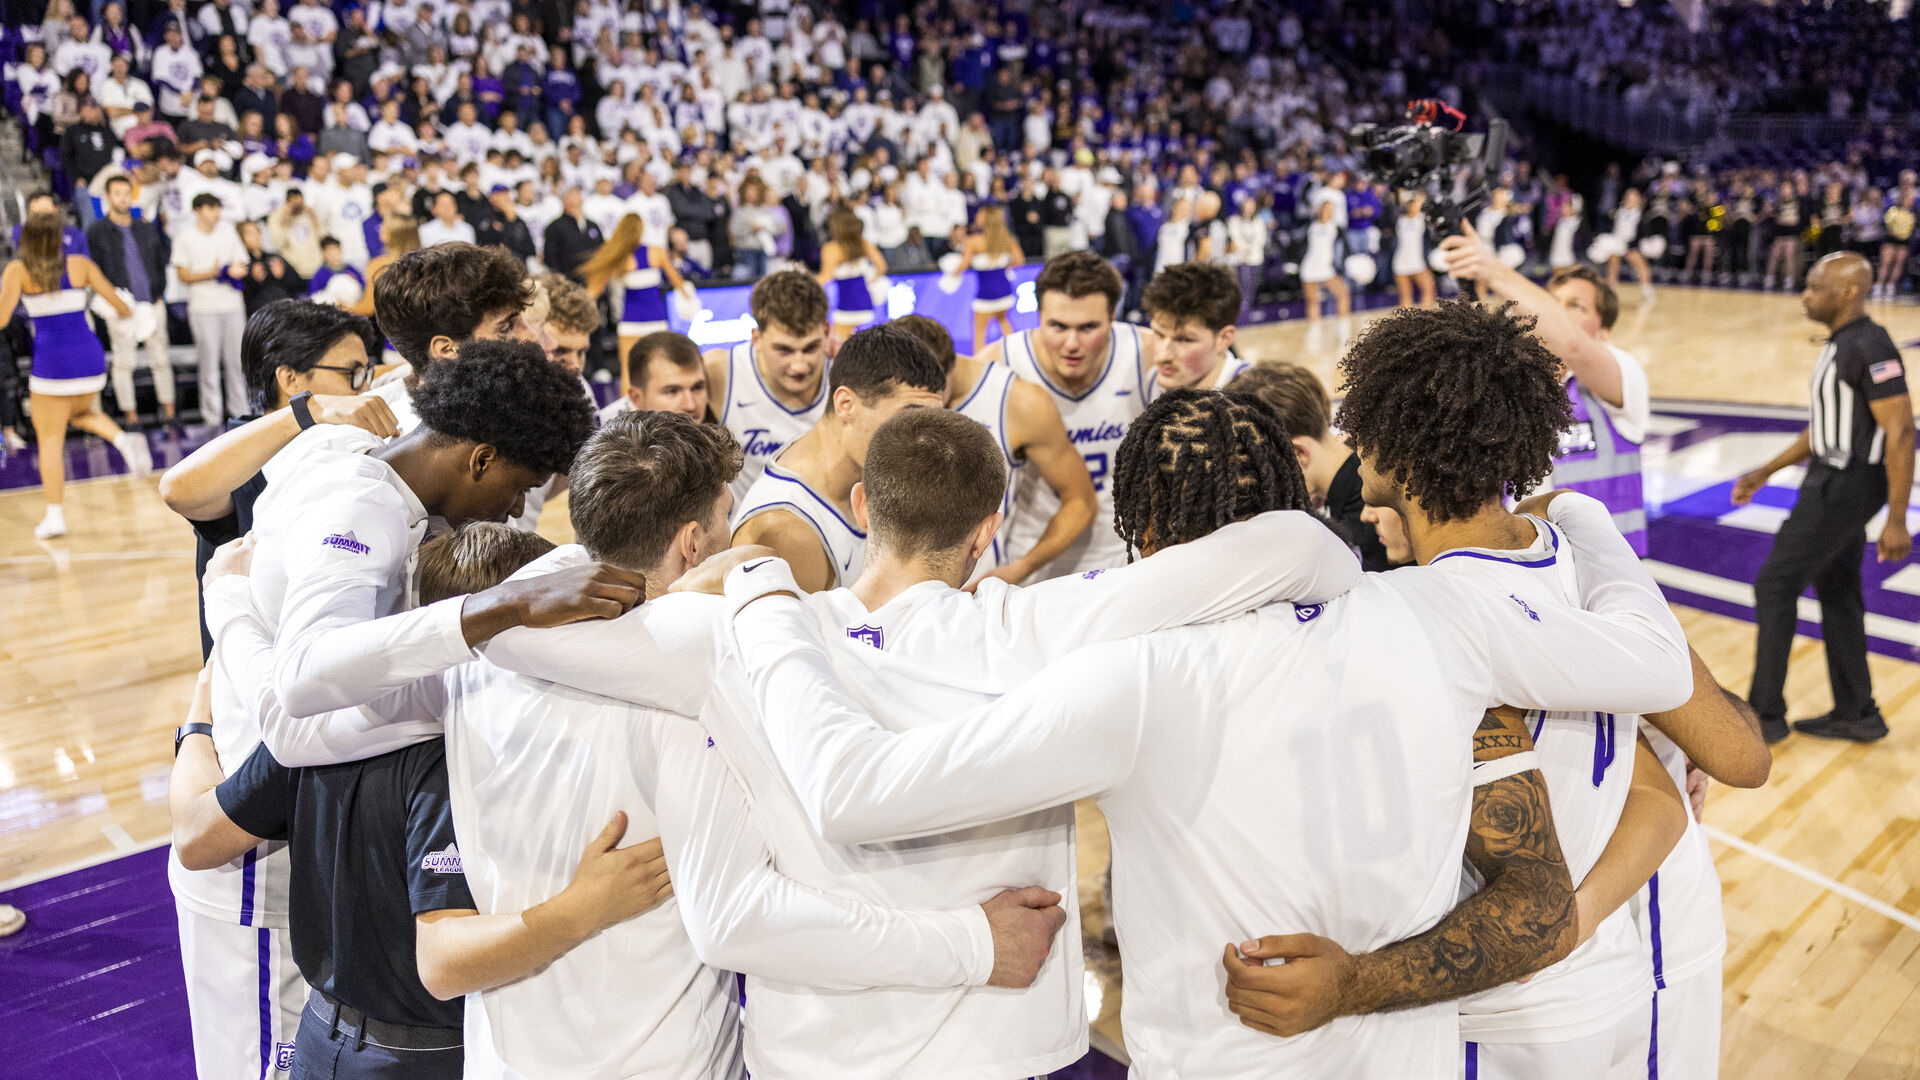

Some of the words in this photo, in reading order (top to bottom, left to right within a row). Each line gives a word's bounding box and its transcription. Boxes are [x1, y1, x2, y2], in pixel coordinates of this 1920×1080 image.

[321, 536, 371, 556] SUMMIT
[332, 544, 360, 555] LEAGUE
[1288, 701, 1414, 873] 10
